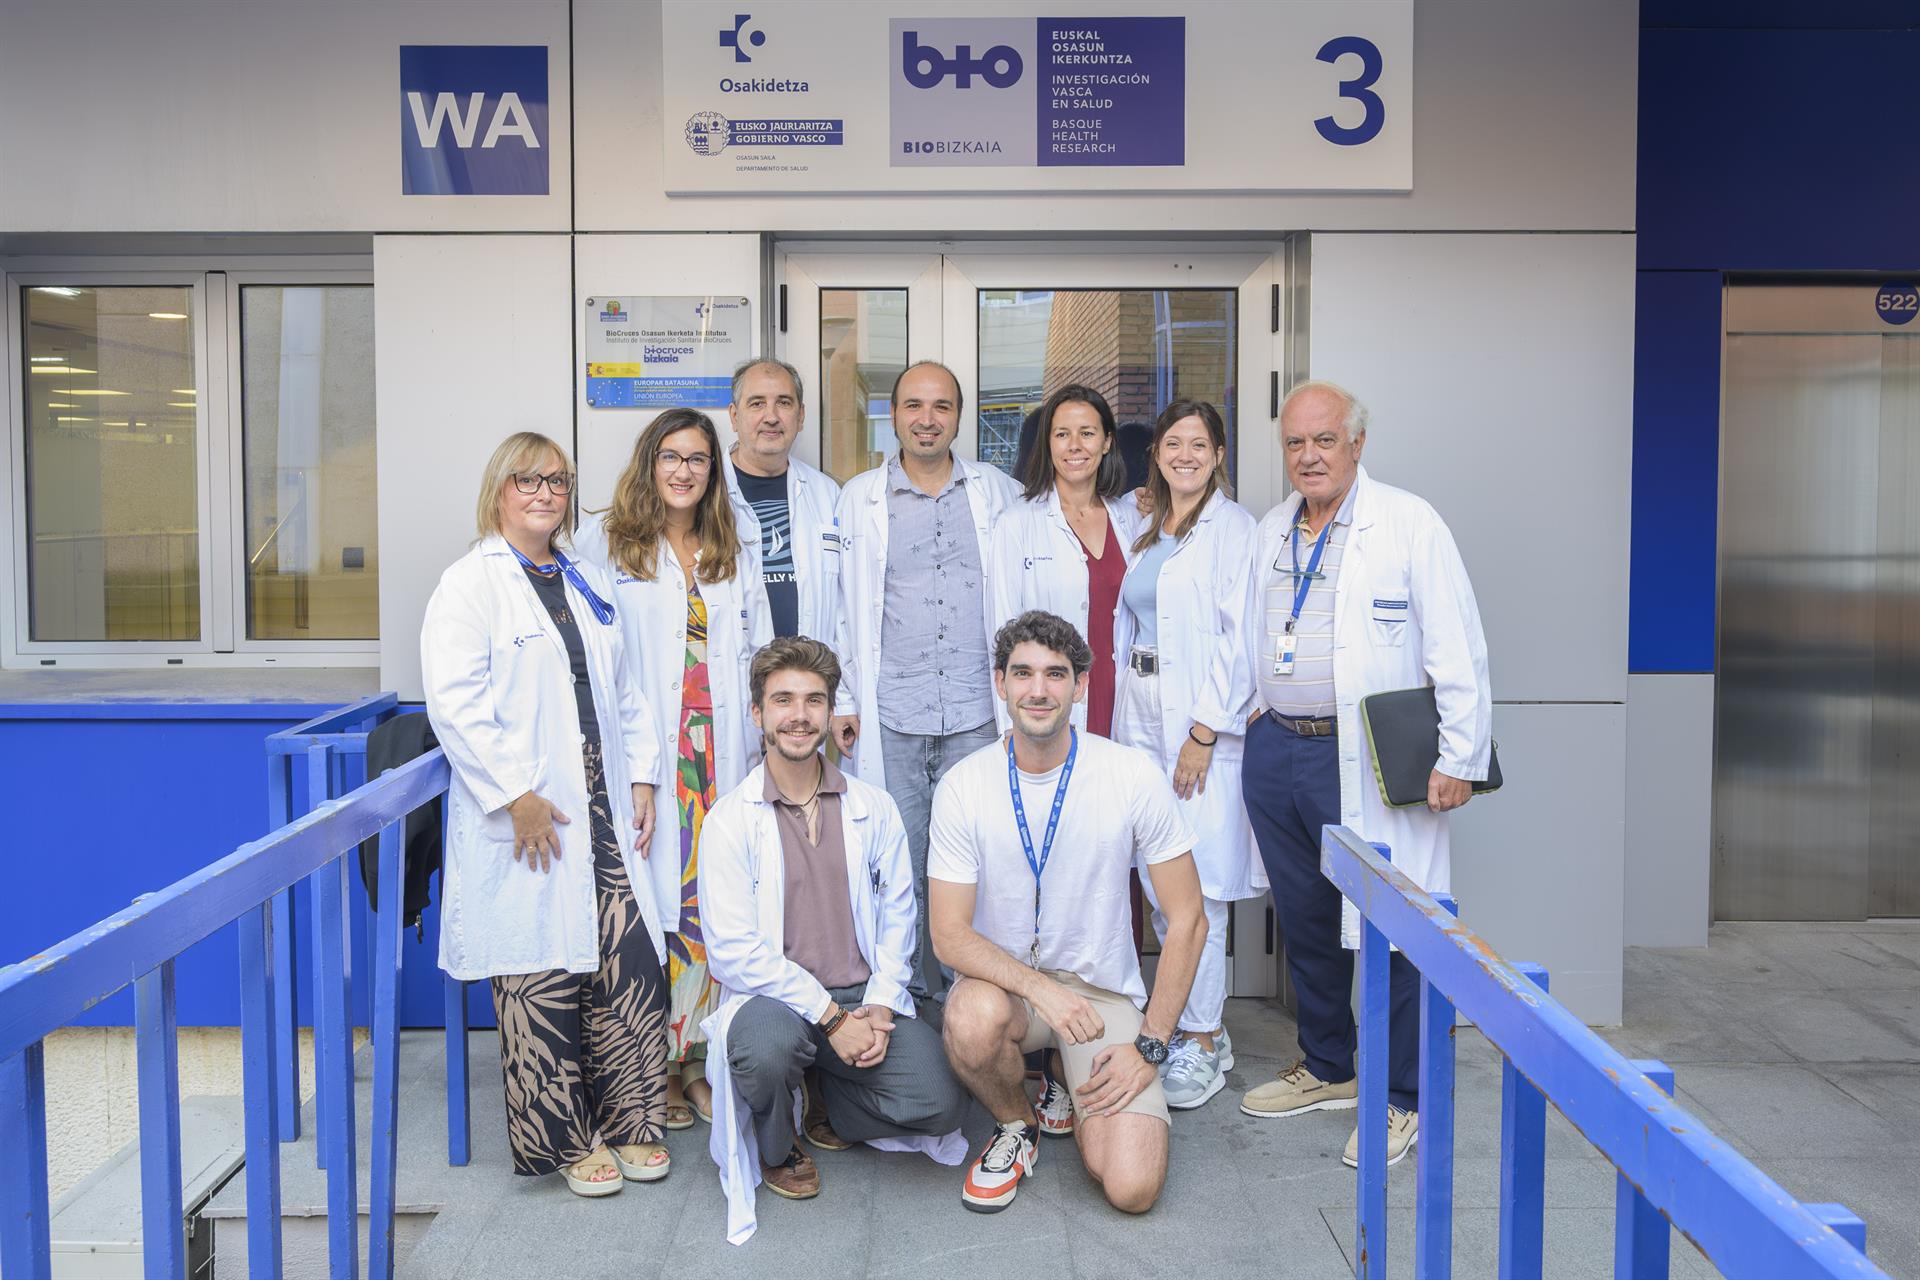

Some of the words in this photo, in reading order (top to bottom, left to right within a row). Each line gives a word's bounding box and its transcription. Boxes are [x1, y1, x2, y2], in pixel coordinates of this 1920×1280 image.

[1052, 31, 1101, 40] EUSKAL
[1052, 43, 1105, 52] OSASUN
[1052, 55, 1133, 65] IKERKUNTZA
[1052, 73, 1150, 85] INVESTIGACIÓN
[719, 78, 809, 93] Osakidetza
[1052, 87, 1093, 97] VASCA
[1313, 36, 1386, 146] 3
[1052, 99, 1069, 109] EN
[1073, 99, 1113, 109] SALUD
[407, 92, 541, 148] WA
[1052, 119, 1103, 129] BASQUE
[735, 122, 767, 131] EUSKO
[769, 122, 833, 132] JAURLARITZA
[735, 134, 790, 143] GOBIERNO
[792, 134, 826, 143] VASCO
[1052, 131, 1099, 141] HEALTH
[903, 141, 1002, 154] BIOBIZKAIA
[1052, 143, 1116, 153] RESEARCH
[1878, 294, 1918, 310] 522
[643, 354, 679, 363] bizkaia
